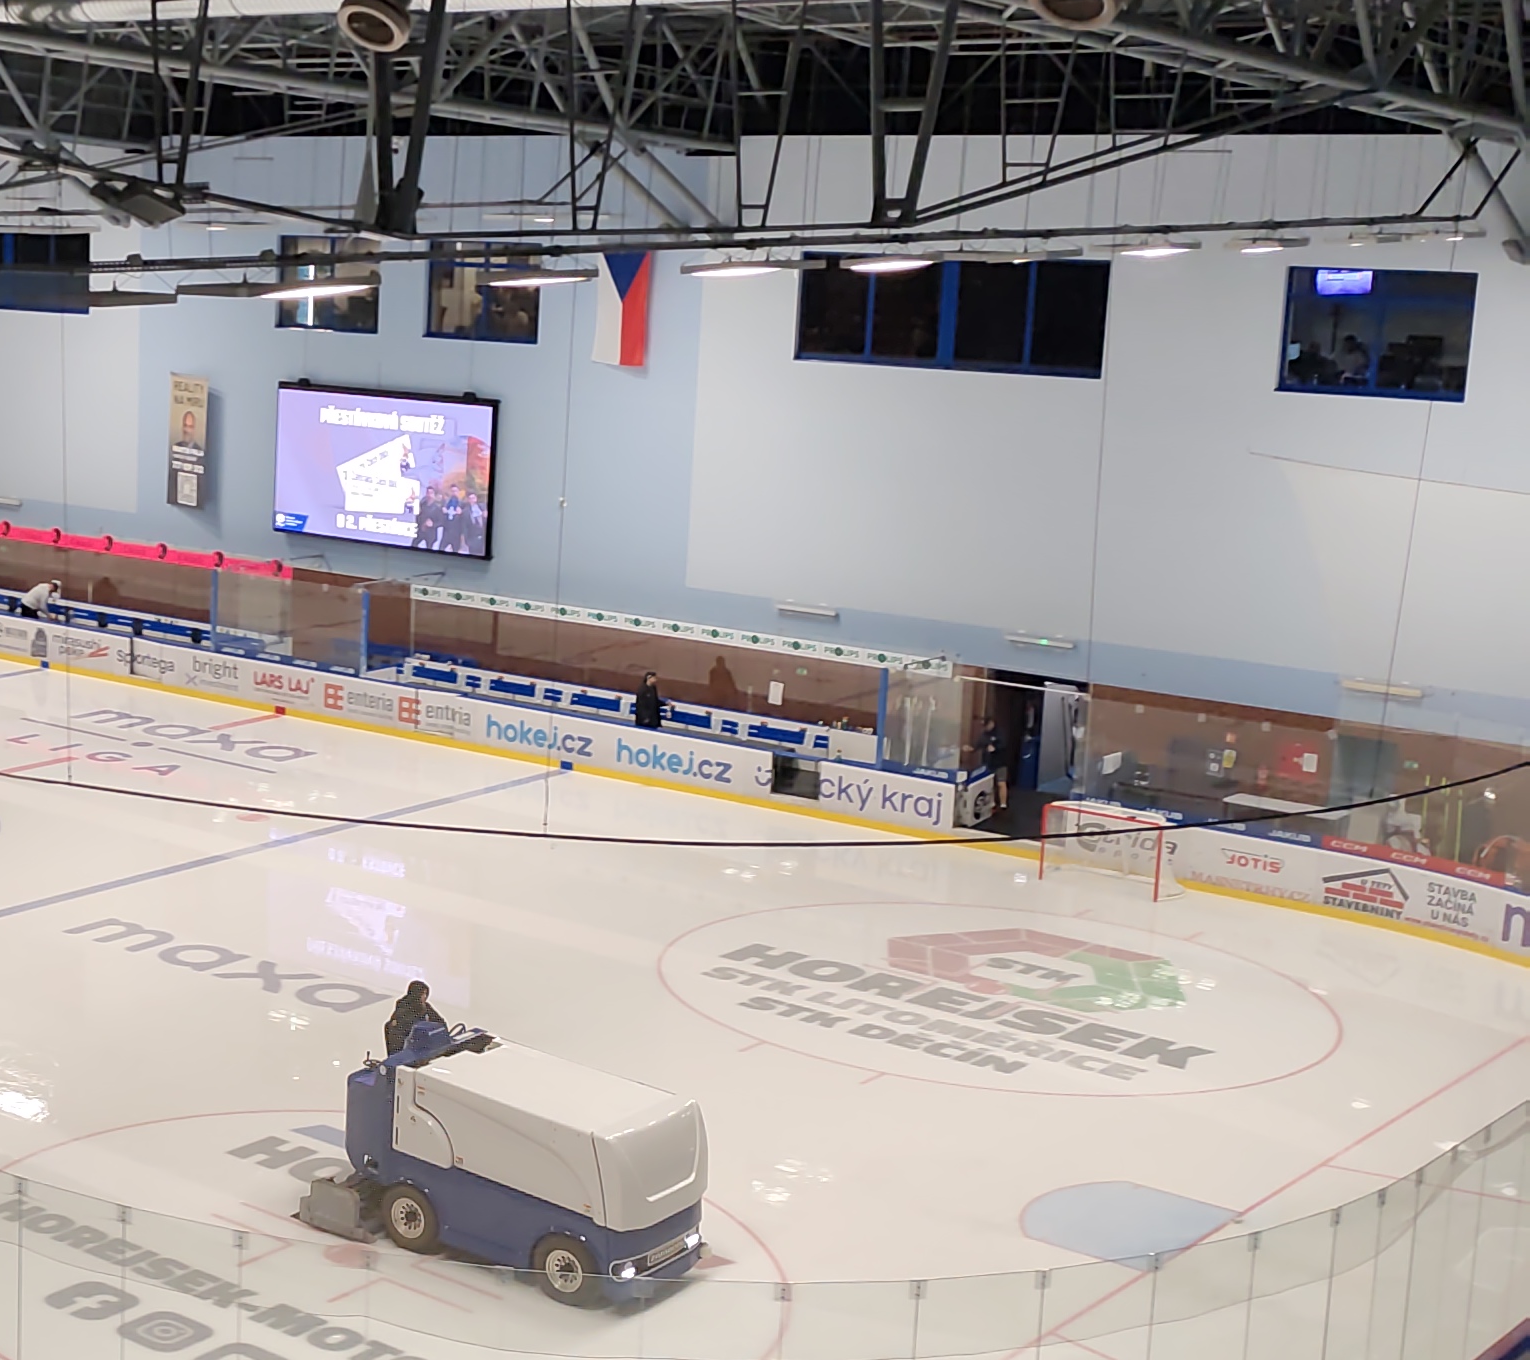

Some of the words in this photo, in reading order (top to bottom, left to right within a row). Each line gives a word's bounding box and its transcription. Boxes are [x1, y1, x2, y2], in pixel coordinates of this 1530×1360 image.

[192, 656, 239, 679] bright
[253, 671, 284, 690] LARS
[347, 690, 393, 713] enteria
[71, 708, 318, 762] maxa
[486, 714, 593, 758] hokej.cz
[6, 733, 181, 776] LIGA
[617, 738, 732, 784] hokej.cz
[820, 776, 874, 812] cký
[882, 783, 943, 826] kraj
[1330, 840, 1368, 853] CCM
[1391, 852, 1428, 865] CCM
[1226, 853, 1281, 874] JOTIS
[1456, 866, 1491, 880] CCM
[1427, 882, 1477, 903] STAVBA
[1431, 910, 1439, 920] U
[1442, 909, 1469, 928] NÁS
[62, 918, 393, 1013] maxa
[987, 956, 1083, 983] STK
[718, 943, 1217, 1070] HOREJSEK
[737, 996, 852, 1028] STK
[701, 966, 808, 996] STK
[807, 990, 1149, 1081] LITOMĚŘICE
